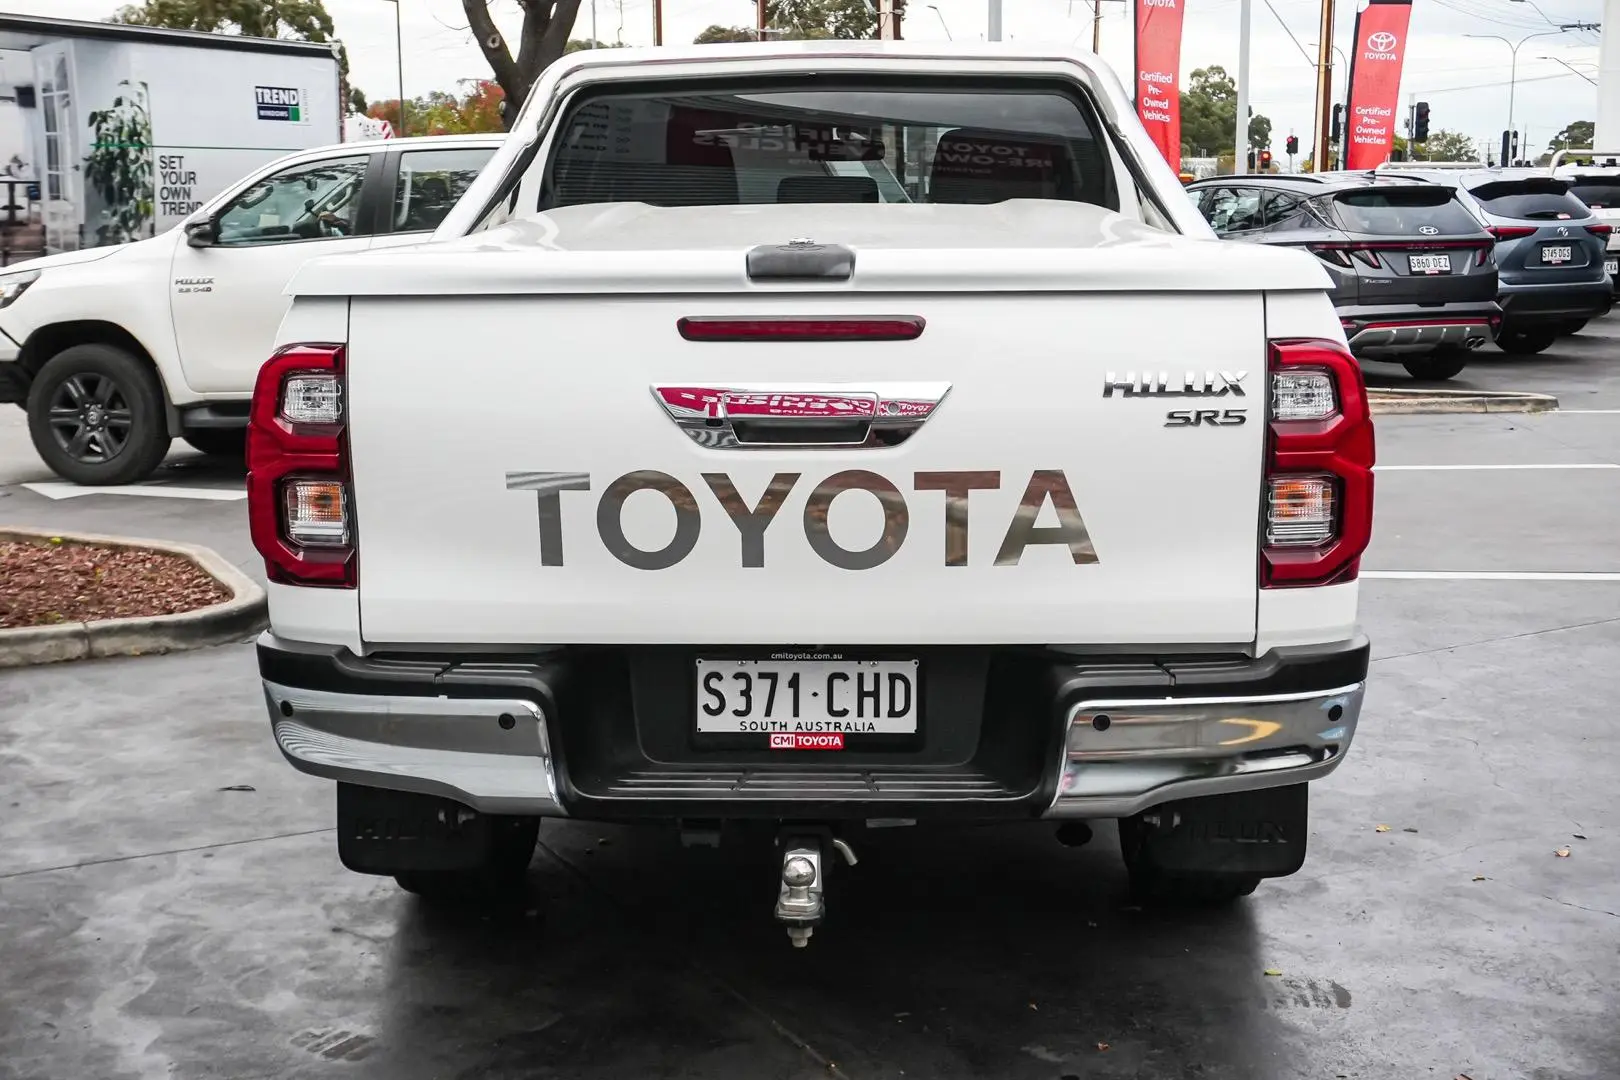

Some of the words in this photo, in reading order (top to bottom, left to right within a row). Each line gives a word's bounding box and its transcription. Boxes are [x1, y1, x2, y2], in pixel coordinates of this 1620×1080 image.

[1363, 52, 1397, 61] TOYOTA
[1140, 71, 1173, 84] Certified
[255, 87, 298, 105] TREND
[1143, 97, 1169, 109] Owned
[1143, 109, 1171, 123] Vehicles
[1355, 106, 1391, 117] Certified
[1362, 116, 1380, 125] Pre-
[1356, 126, 1386, 136] Owned
[1354, 135, 1387, 146] Vehicles
[159, 155, 184, 170] SET
[160, 171, 197, 185] YOUR
[160, 186, 192, 201] OWN
[1411, 257, 1431, 269] S860
[1433, 257, 1449, 268] DEZ
[1102, 371, 1249, 398] HILUX
[1163, 408, 1248, 428] SR5
[505, 469, 1101, 571] TOYOTA
[771, 652, 843, 661] cmitoyota.com.au
[739, 720, 788, 732] SOUTH
[795, 720, 876, 732] AUSTRALIA
[772, 735, 795, 747] CMI
[796, 735, 842, 747] TOYOTA
